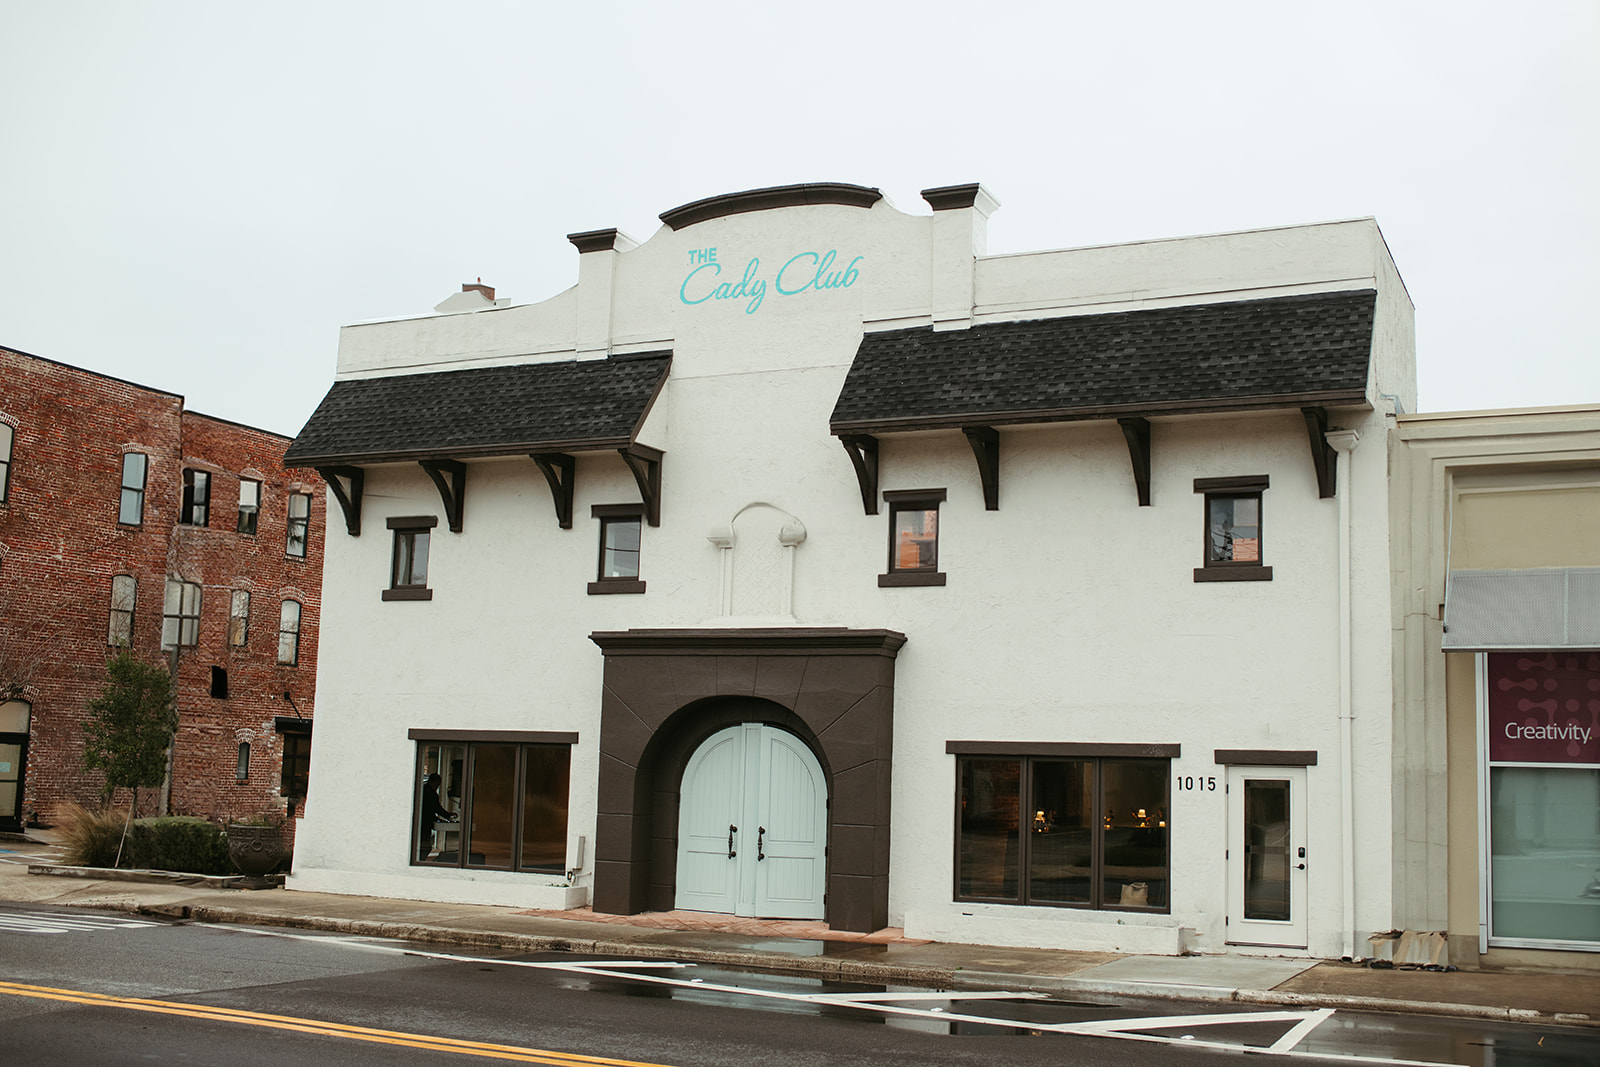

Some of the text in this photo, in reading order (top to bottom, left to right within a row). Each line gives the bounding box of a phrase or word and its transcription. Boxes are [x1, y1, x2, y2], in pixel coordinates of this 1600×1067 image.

[688, 247, 717, 264] THE
[680, 249, 864, 314] Cady Club
[1505, 722, 1593, 744] Creativity.
[1177, 776, 1216, 791] 1015
